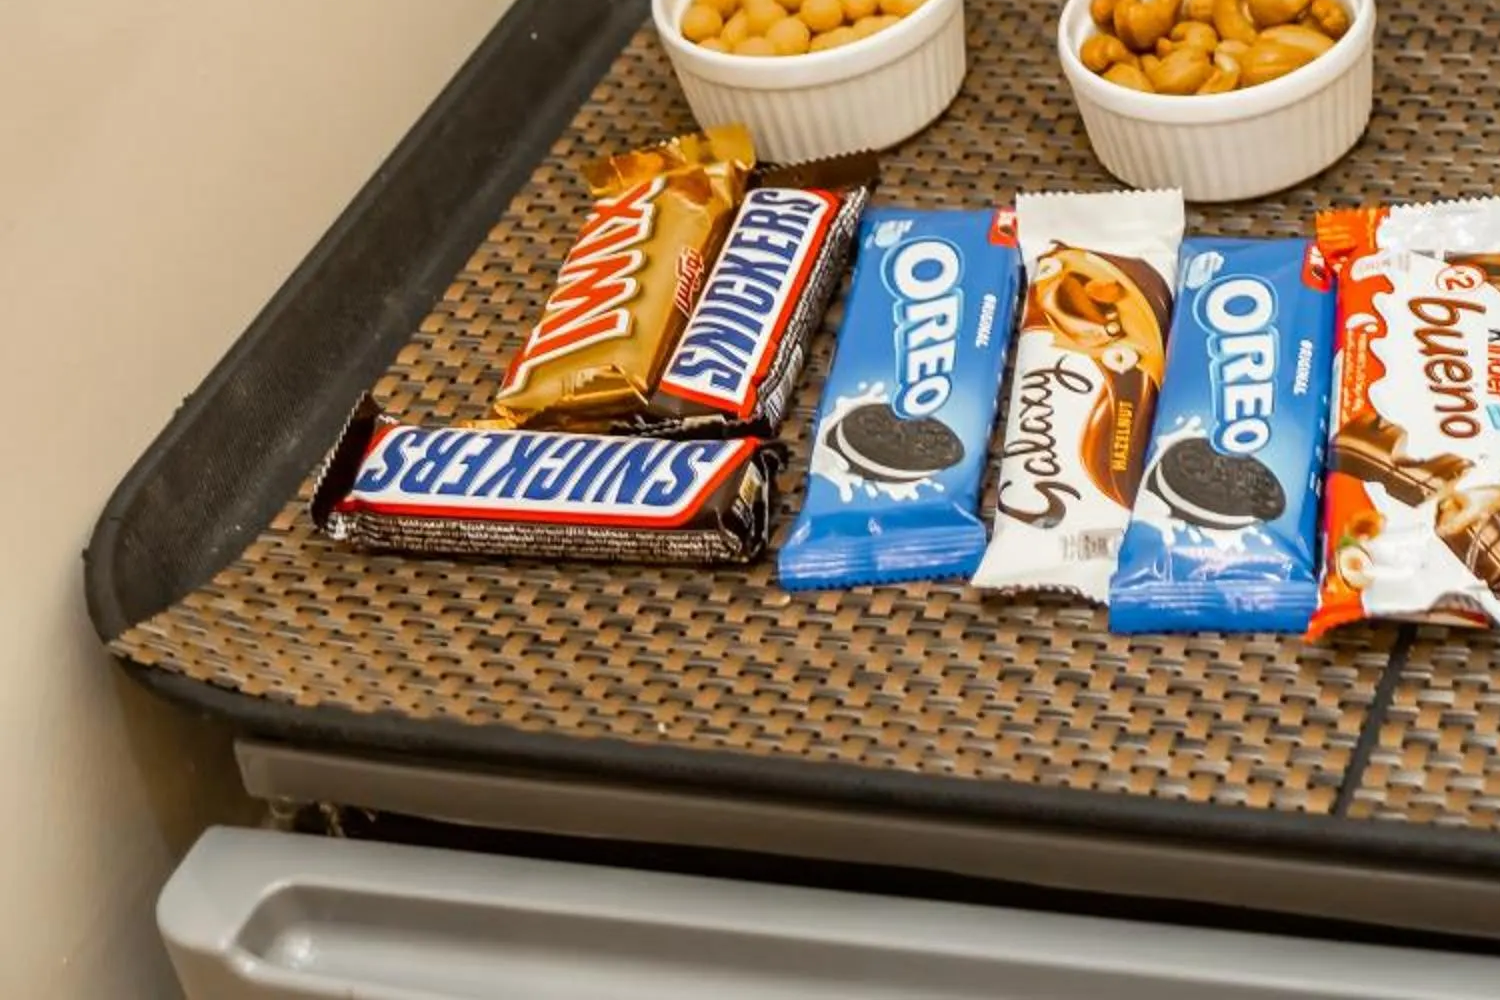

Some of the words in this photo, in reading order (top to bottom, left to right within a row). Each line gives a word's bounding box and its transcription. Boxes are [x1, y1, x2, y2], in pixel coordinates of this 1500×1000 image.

[668, 190, 821, 392] SNICKERS
[892, 239, 960, 418] OREO
[1205, 278, 1276, 454] OREO
[1408, 296, 1488, 440] bueno
[352, 428, 730, 509] SNICKERS
[997, 353, 1094, 530] Galaxy
[1110, 400, 1135, 471] HAZELNUT
